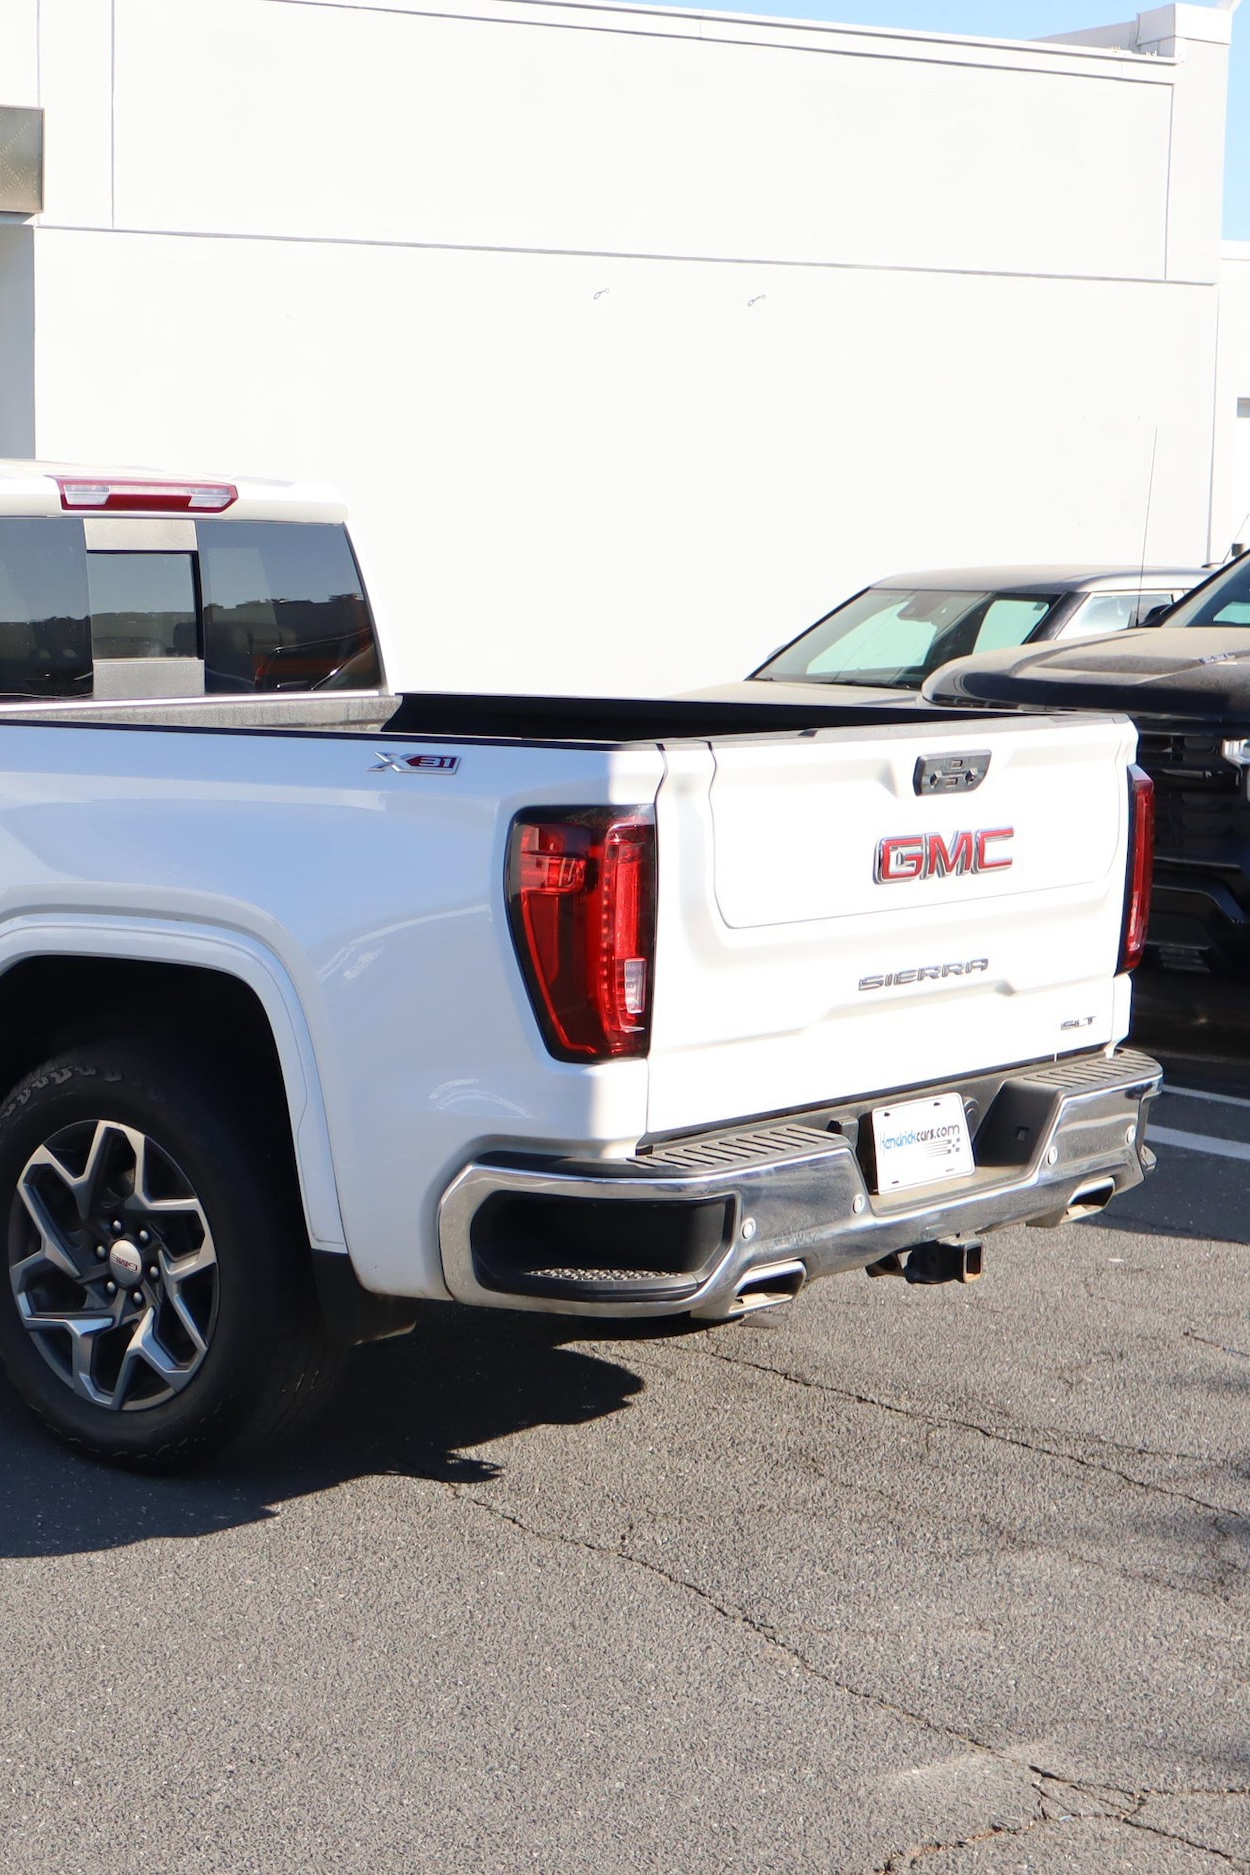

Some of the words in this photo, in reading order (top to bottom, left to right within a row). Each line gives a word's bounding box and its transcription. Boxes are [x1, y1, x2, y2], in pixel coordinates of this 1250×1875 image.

[366, 751, 461, 775] X31
[872, 825, 1015, 885] GMC
[858, 957, 989, 992] SIERRA
[1060, 1015, 1097, 1031] SLT
